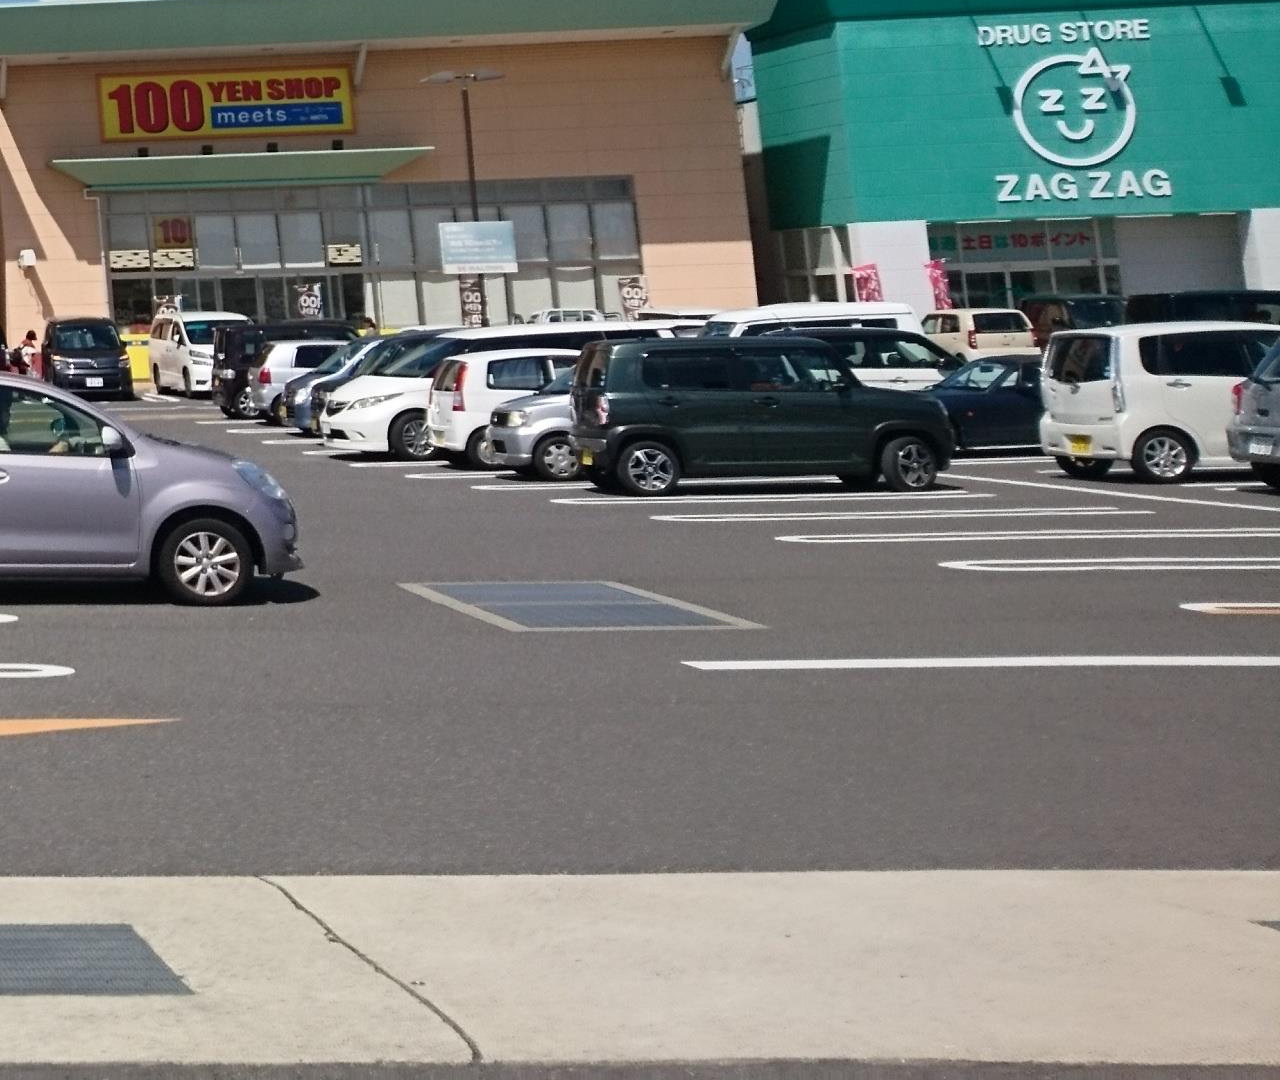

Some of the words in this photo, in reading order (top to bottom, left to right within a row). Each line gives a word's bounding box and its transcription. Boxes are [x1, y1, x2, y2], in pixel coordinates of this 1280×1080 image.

[977, 22, 1052, 46] DRUG
[1059, 19, 1151, 42] STORE
[207, 80, 263, 102] YEN
[267, 76, 341, 101] SHOP
[108, 80, 205, 134] 100
[216, 107, 287, 124] meets
[996, 173, 1079, 202] ZAG
[1088, 169, 1172, 199] ZAG
